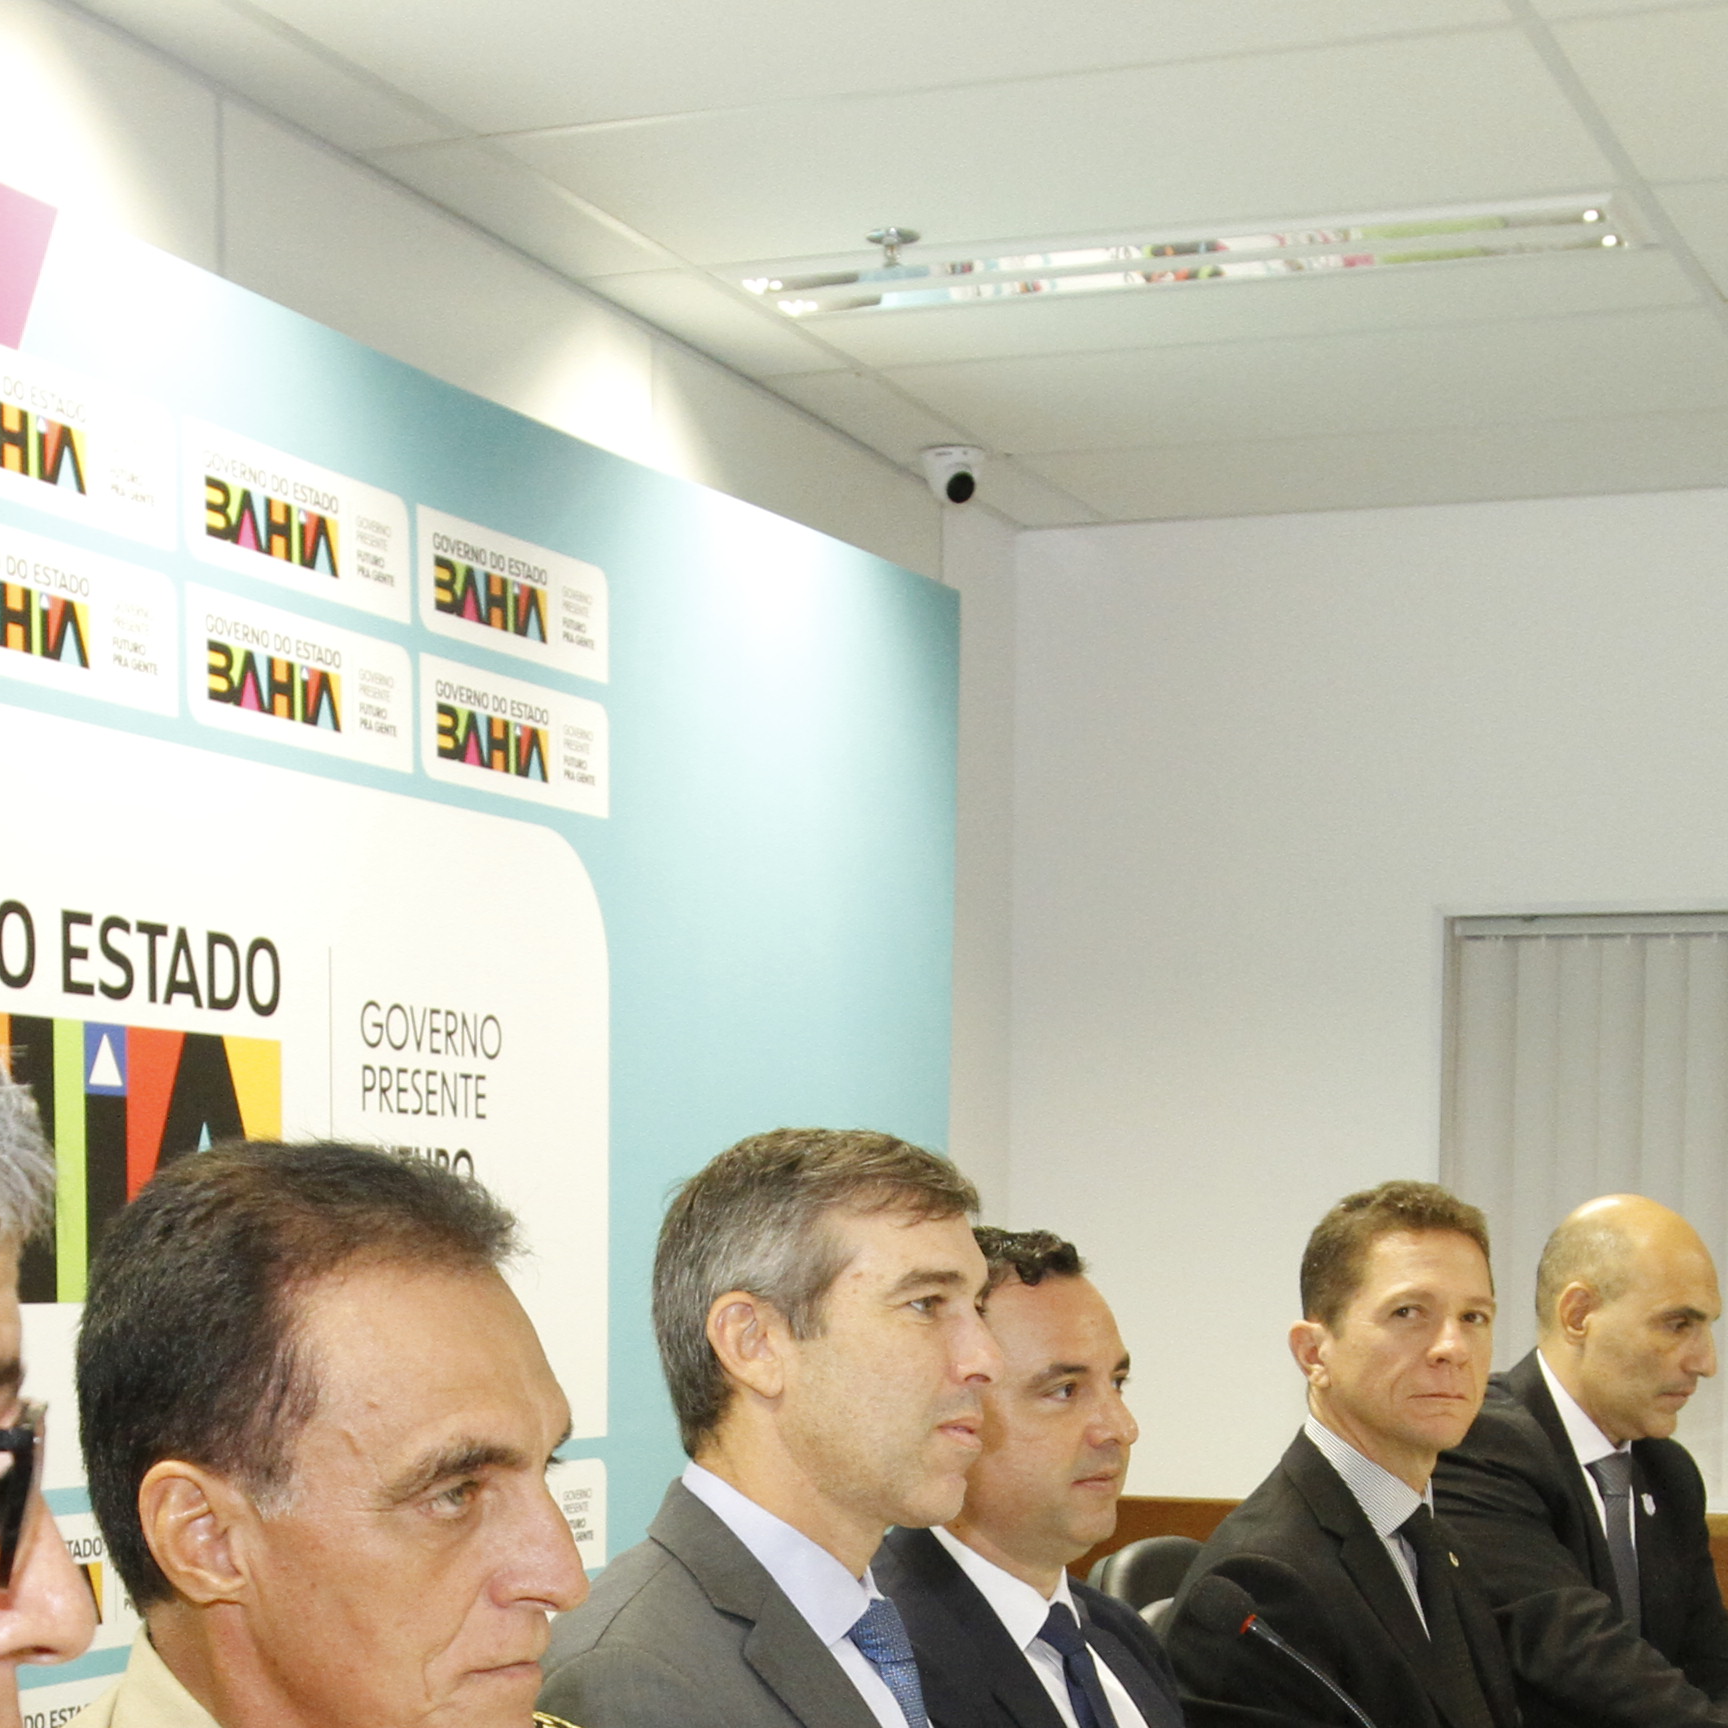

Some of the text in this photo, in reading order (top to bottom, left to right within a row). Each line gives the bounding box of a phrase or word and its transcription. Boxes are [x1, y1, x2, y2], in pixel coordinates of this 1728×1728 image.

[203, 451, 339, 515] GOVERNO DO ESTADO
[205, 474, 340, 580] BAHIA
[6, 555, 28, 579] DO
[33, 563, 89, 597] ESTADO
[433, 532, 548, 586] GOVERNO DO ESTADO
[433, 553, 548, 644] BAHIA
[206, 613, 341, 669] GOVERNO DO ESTADO
[207, 638, 342, 734] BAHIA
[435, 679, 549, 726] GOVERNO DO ESTADO
[436, 701, 549, 784] BAHIA
[61, 909, 281, 1017] ESTADO
[360, 1001, 502, 1060] GOVERNO
[362, 1065, 487, 1119] PRESENTE
[66, 1537, 102, 1558] TADO
